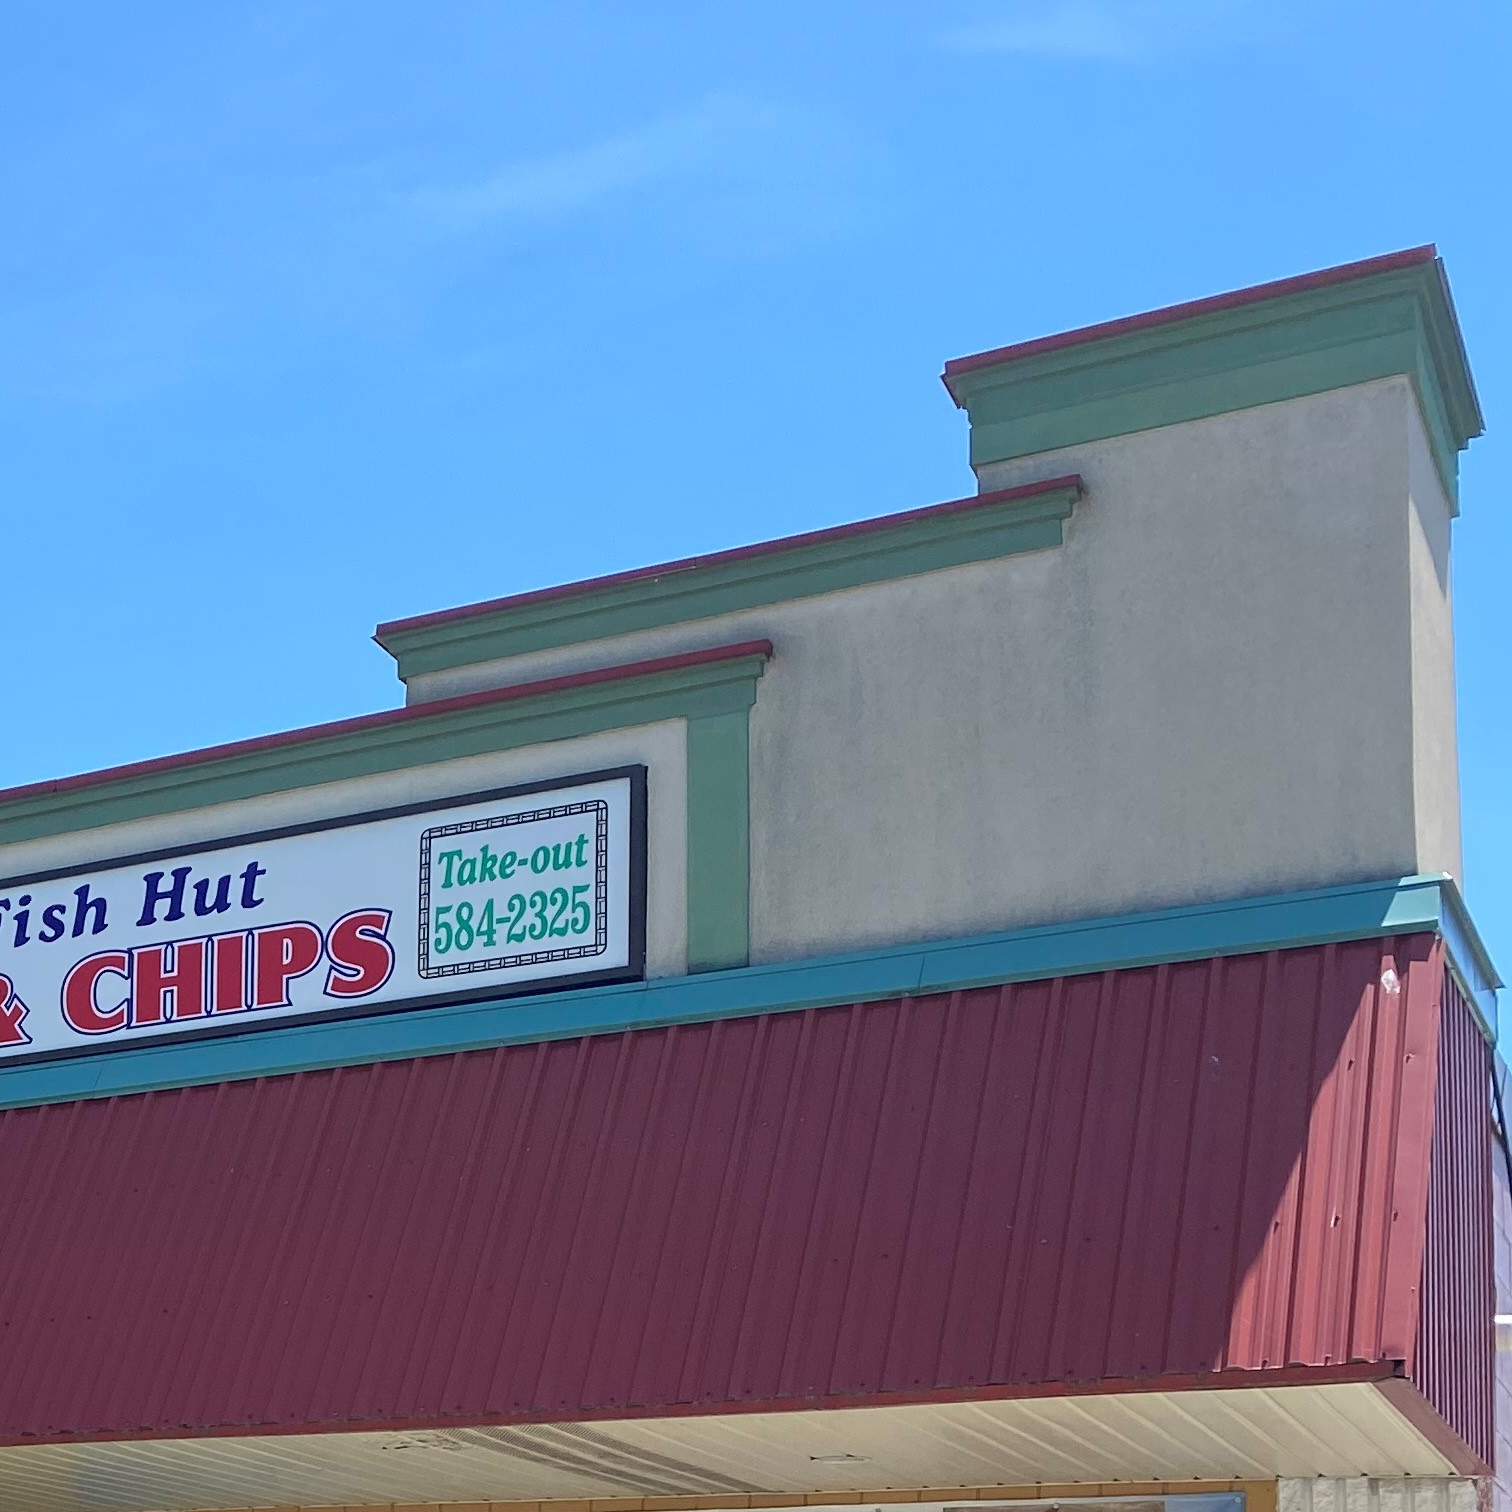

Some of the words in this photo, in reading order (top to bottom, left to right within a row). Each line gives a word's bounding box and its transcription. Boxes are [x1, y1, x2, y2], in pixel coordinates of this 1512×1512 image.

[136, 861, 268, 927] Hut
[438, 833, 589, 889] Take-out
[434, 884, 591, 954] 584-2325
[61, 908, 395, 1036] CHIPS
